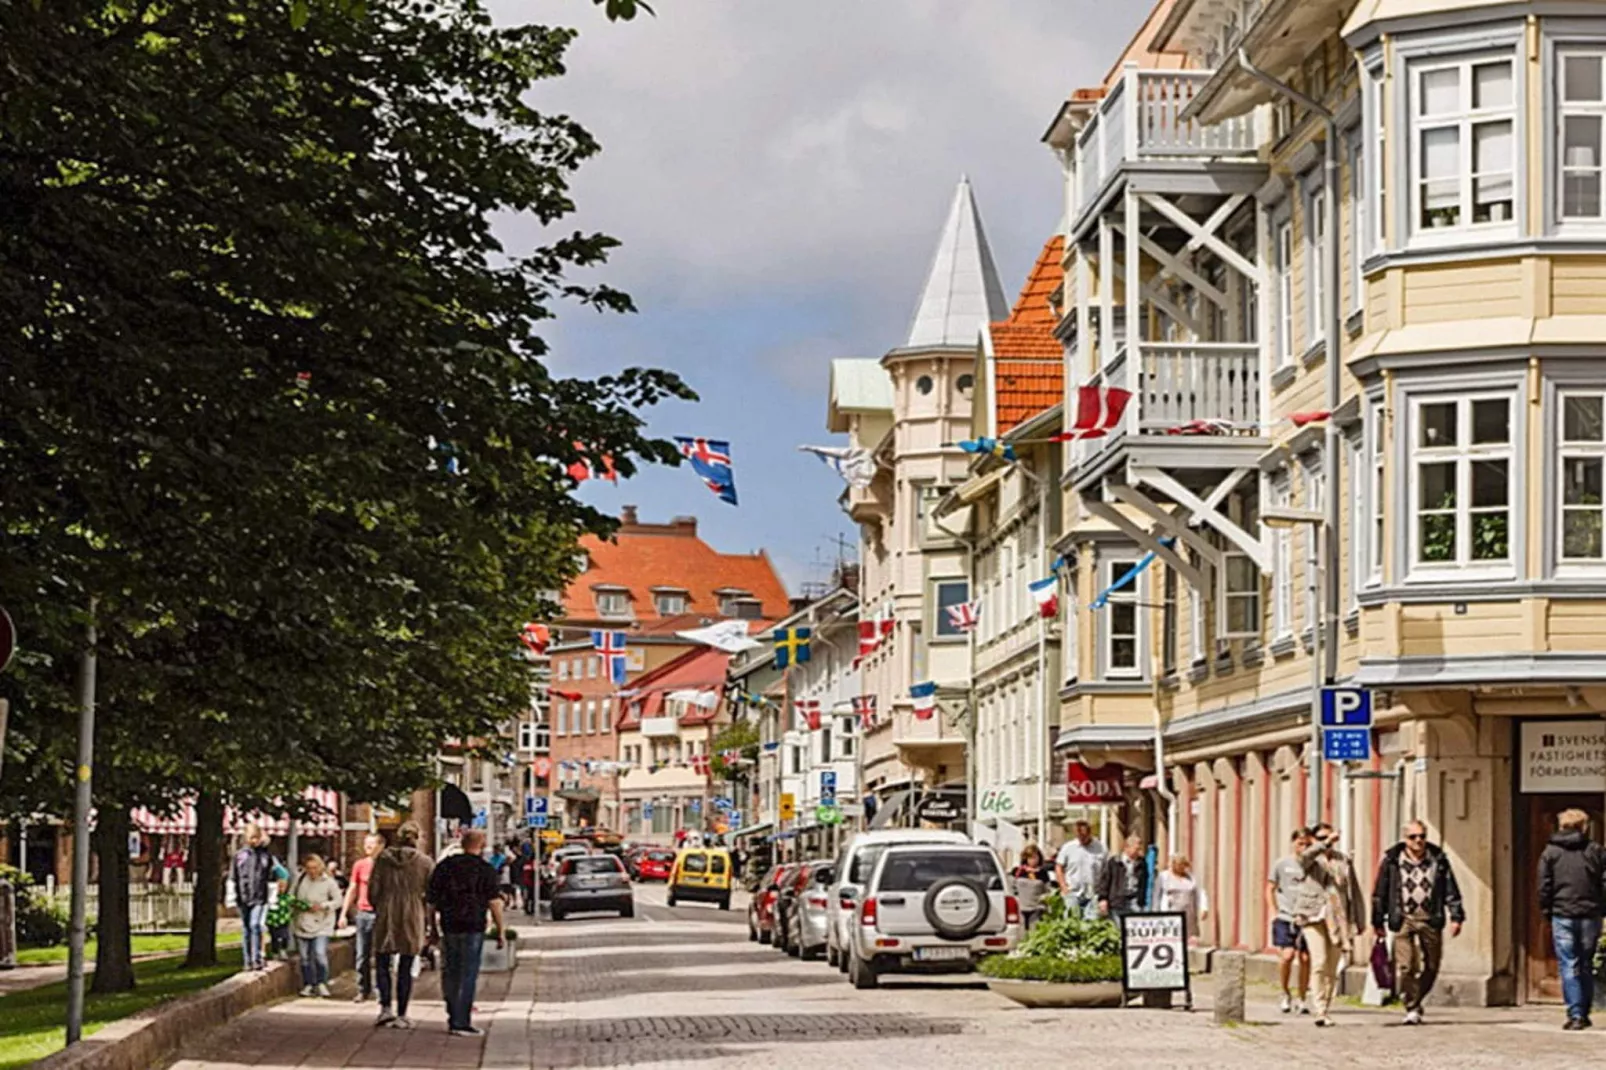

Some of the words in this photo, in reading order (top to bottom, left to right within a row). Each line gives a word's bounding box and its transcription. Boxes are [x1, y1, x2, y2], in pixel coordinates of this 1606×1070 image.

[1335, 691, 1361, 724] P
[824, 773, 833, 784] P
[1068, 780, 1122, 797] SODA
[532, 799, 544, 812] P
[981, 790, 1014, 813] life
[1128, 944, 1175, 970] 79
